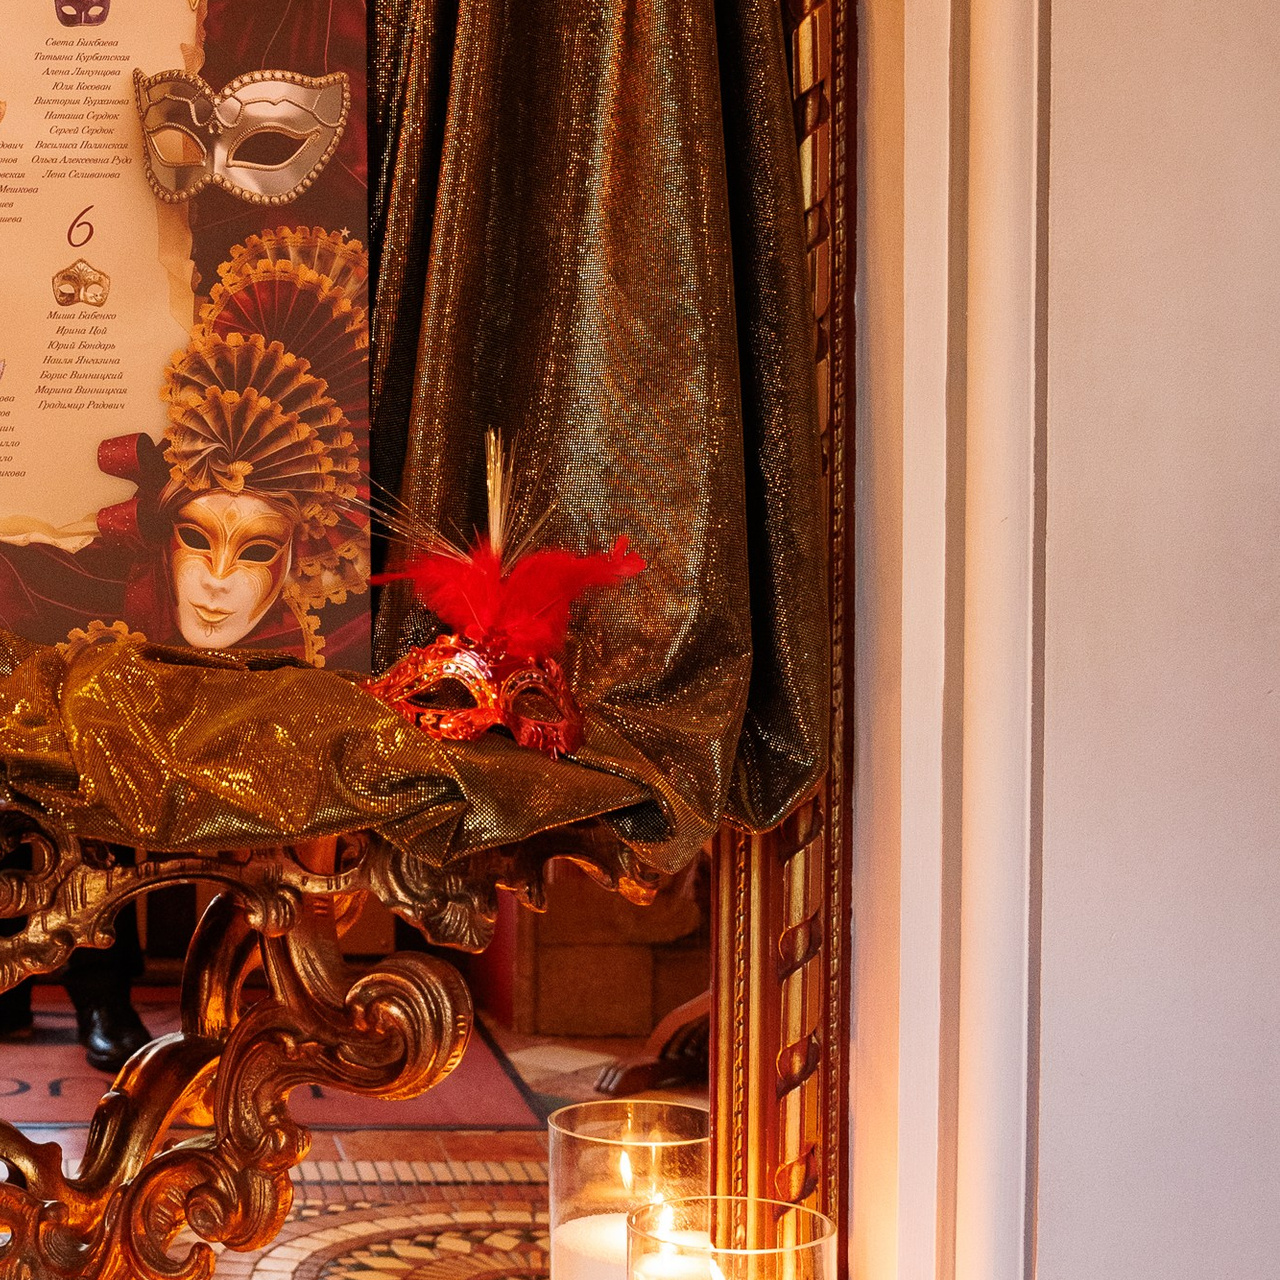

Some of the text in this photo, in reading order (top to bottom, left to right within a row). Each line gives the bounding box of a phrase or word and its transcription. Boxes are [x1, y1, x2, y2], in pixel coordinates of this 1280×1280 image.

[45, 38, 118, 47] Света Бикбаева
[34, 52, 130, 62] Татьяна Курбатская
[42, 67, 70, 75] Алена
[52, 82, 73, 90] Юля
[34, 97, 80, 107] Виктория
[49, 126, 79, 136] Сергей
[31, 155, 57, 164] Ольга
[42, 170, 120, 178] Лена Селиванова
[67, 205, 94, 248] 6
[47, 311, 116, 320] Миша Бабенко
[56, 327, 107, 336] Ирина Цой
[47, 341, 116, 351] Юрий Бондарь
[39, 371, 123, 380] Борис Винницкий
[35, 386, 128, 395] Марина Винницкая
[87, 401, 125, 409] Радович
